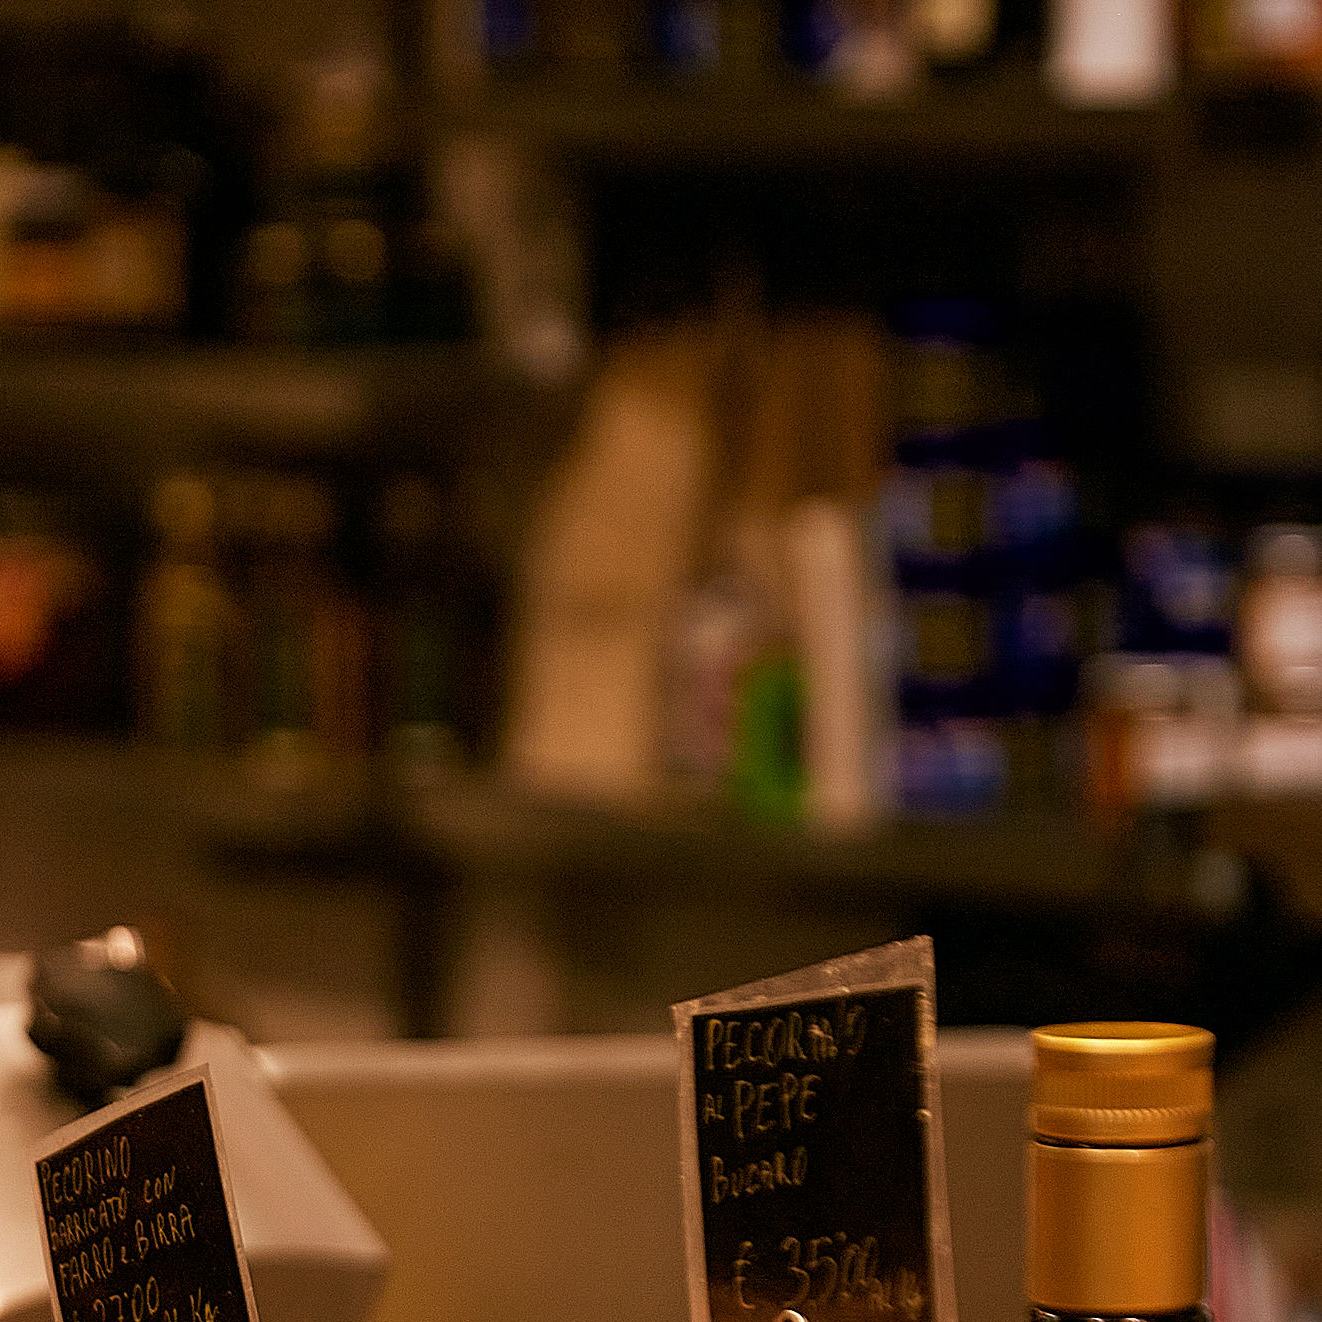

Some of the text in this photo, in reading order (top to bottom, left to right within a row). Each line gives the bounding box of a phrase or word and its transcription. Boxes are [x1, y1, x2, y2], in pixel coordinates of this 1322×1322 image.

[734, 1071, 822, 1139] PEPE
[40, 1136, 130, 1211] PECORINO
[143, 1165, 176, 1203] CON
[59, 1236, 115, 1298] FARRO
[134, 1204, 196, 1255] BIRRA
